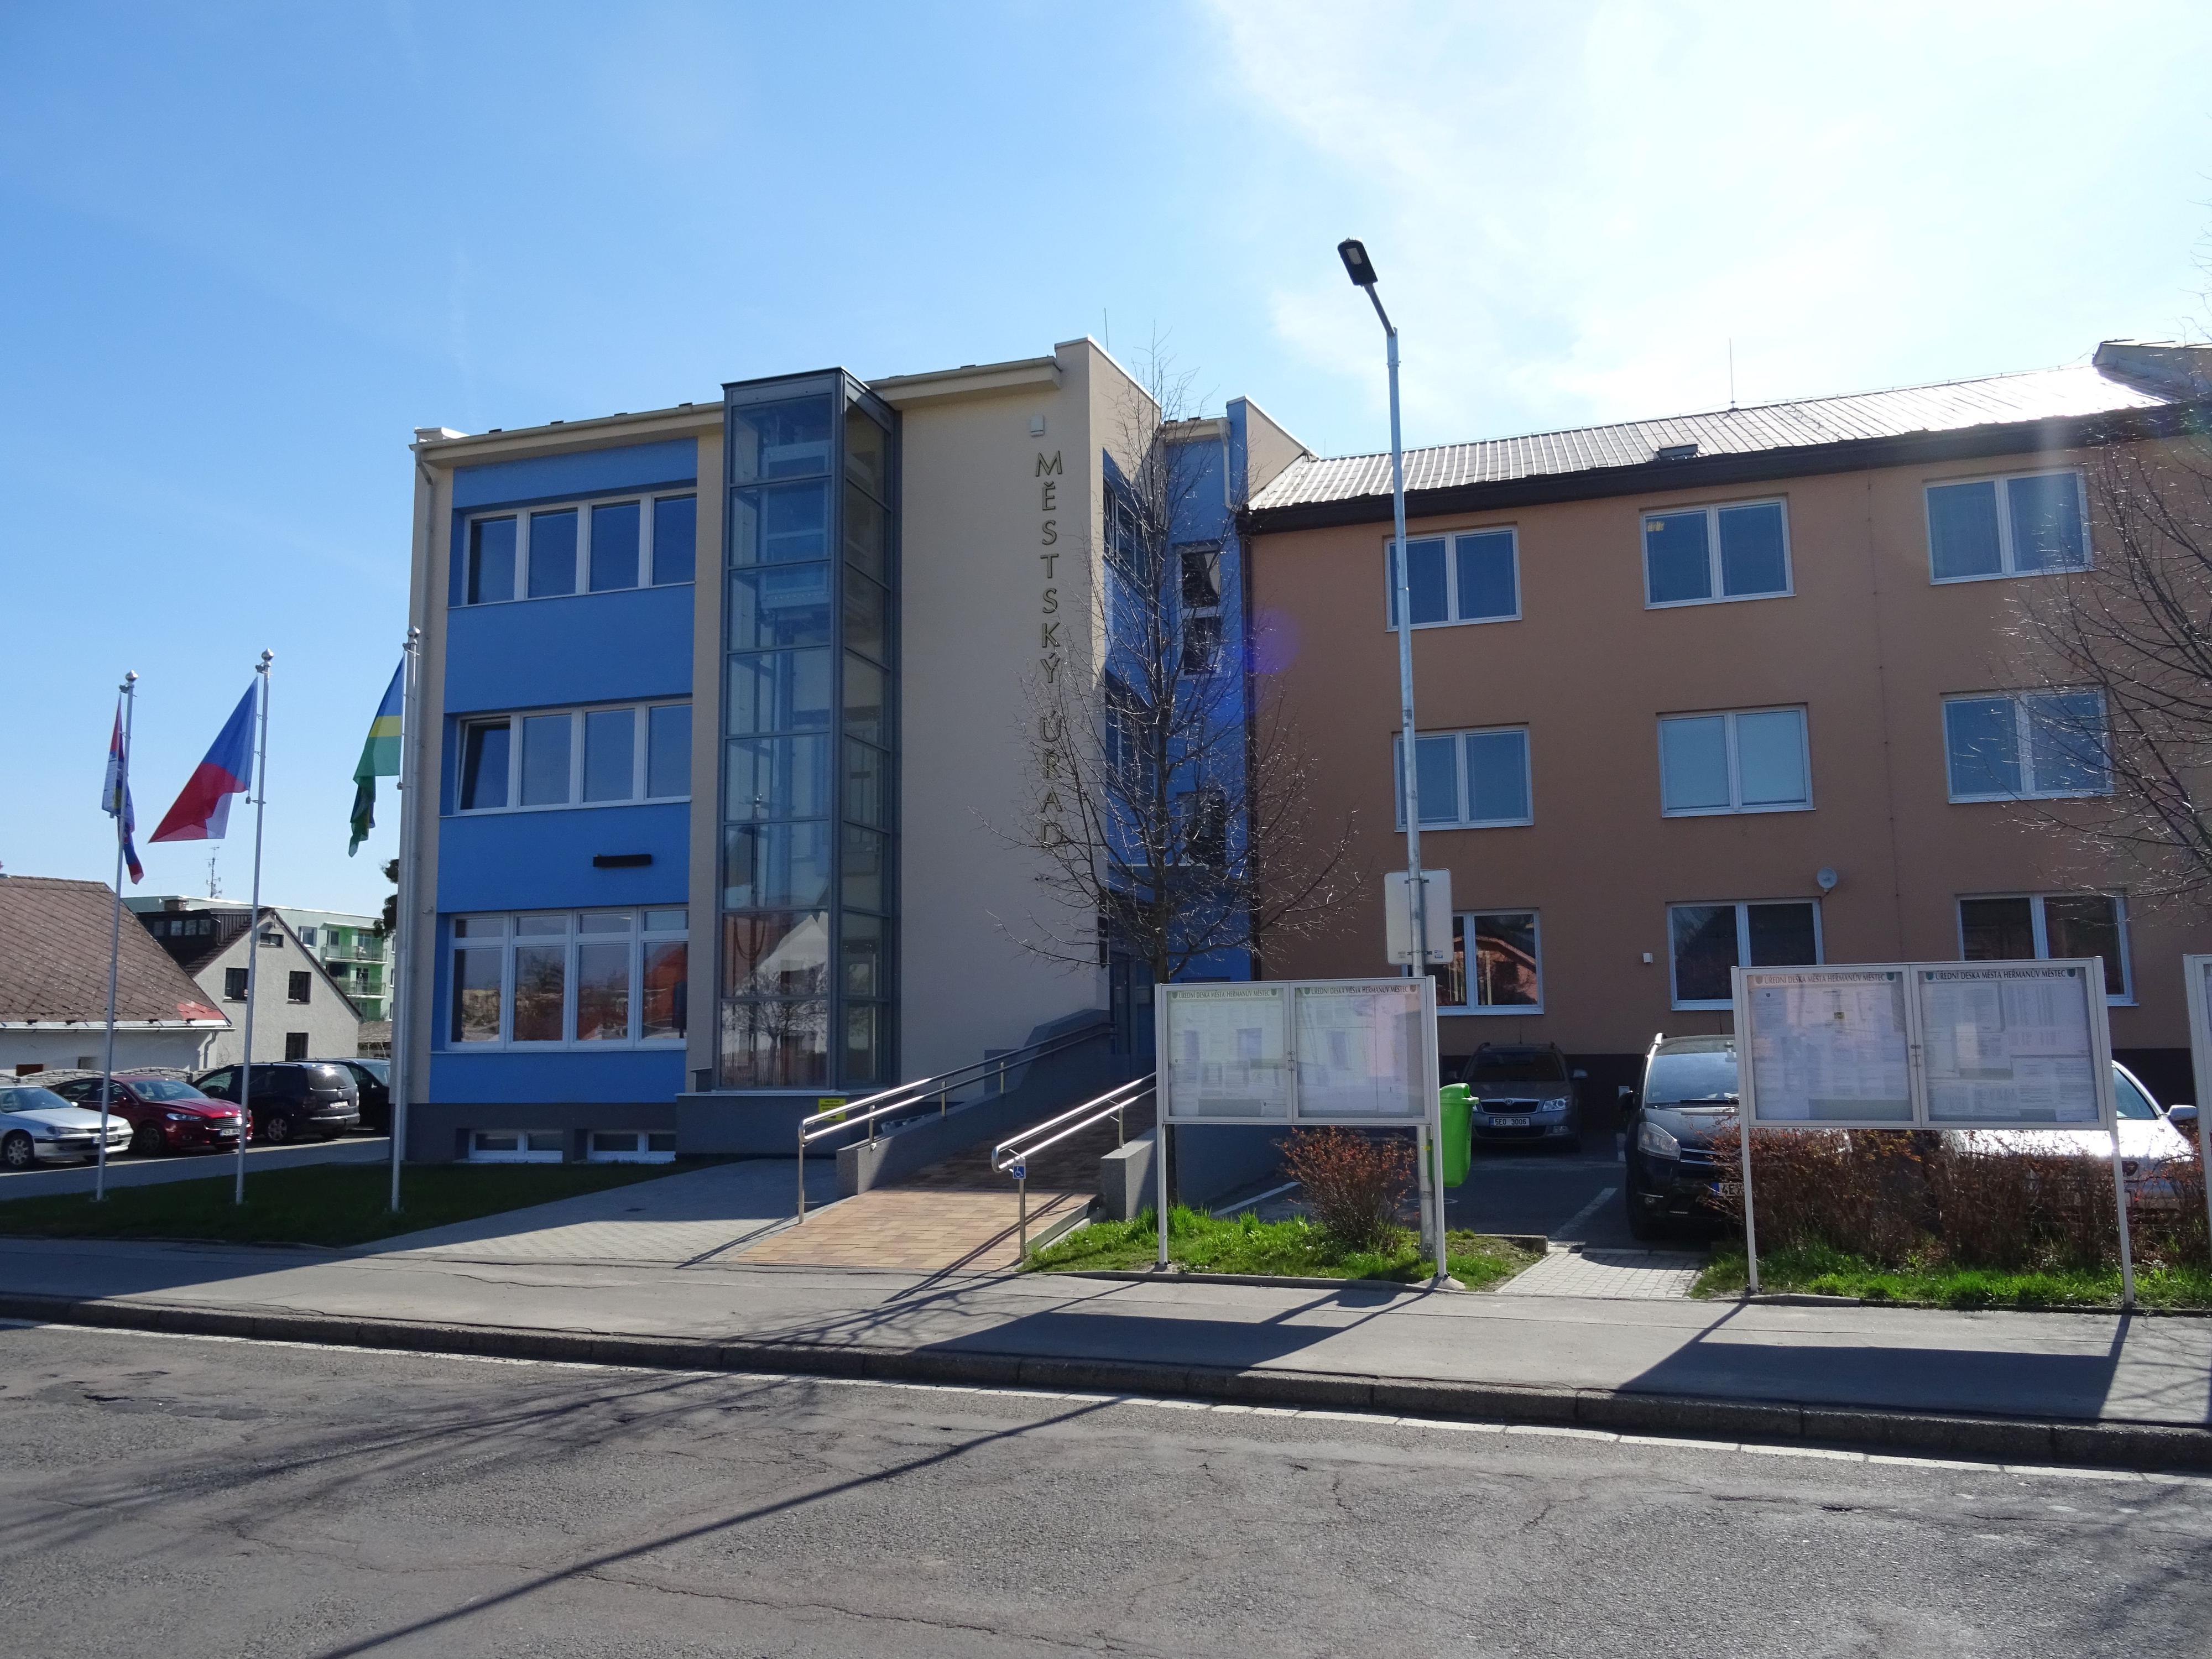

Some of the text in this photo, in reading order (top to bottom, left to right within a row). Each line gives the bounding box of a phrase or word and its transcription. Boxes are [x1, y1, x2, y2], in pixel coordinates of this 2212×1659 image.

[1035, 450, 1065, 848] MĚSTSKÝ ÚŘAD
[1788, 975, 1806, 983] DESKA
[1808, 974, 1826, 983] MĚSTA
[1863, 972, 1885, 981] MĚSTEC
[1982, 969, 2002, 978] MĚSTA
[2004, 969, 2039, 978] HEŘMANŮV
[2042, 968, 2065, 977] MĚSTEC
